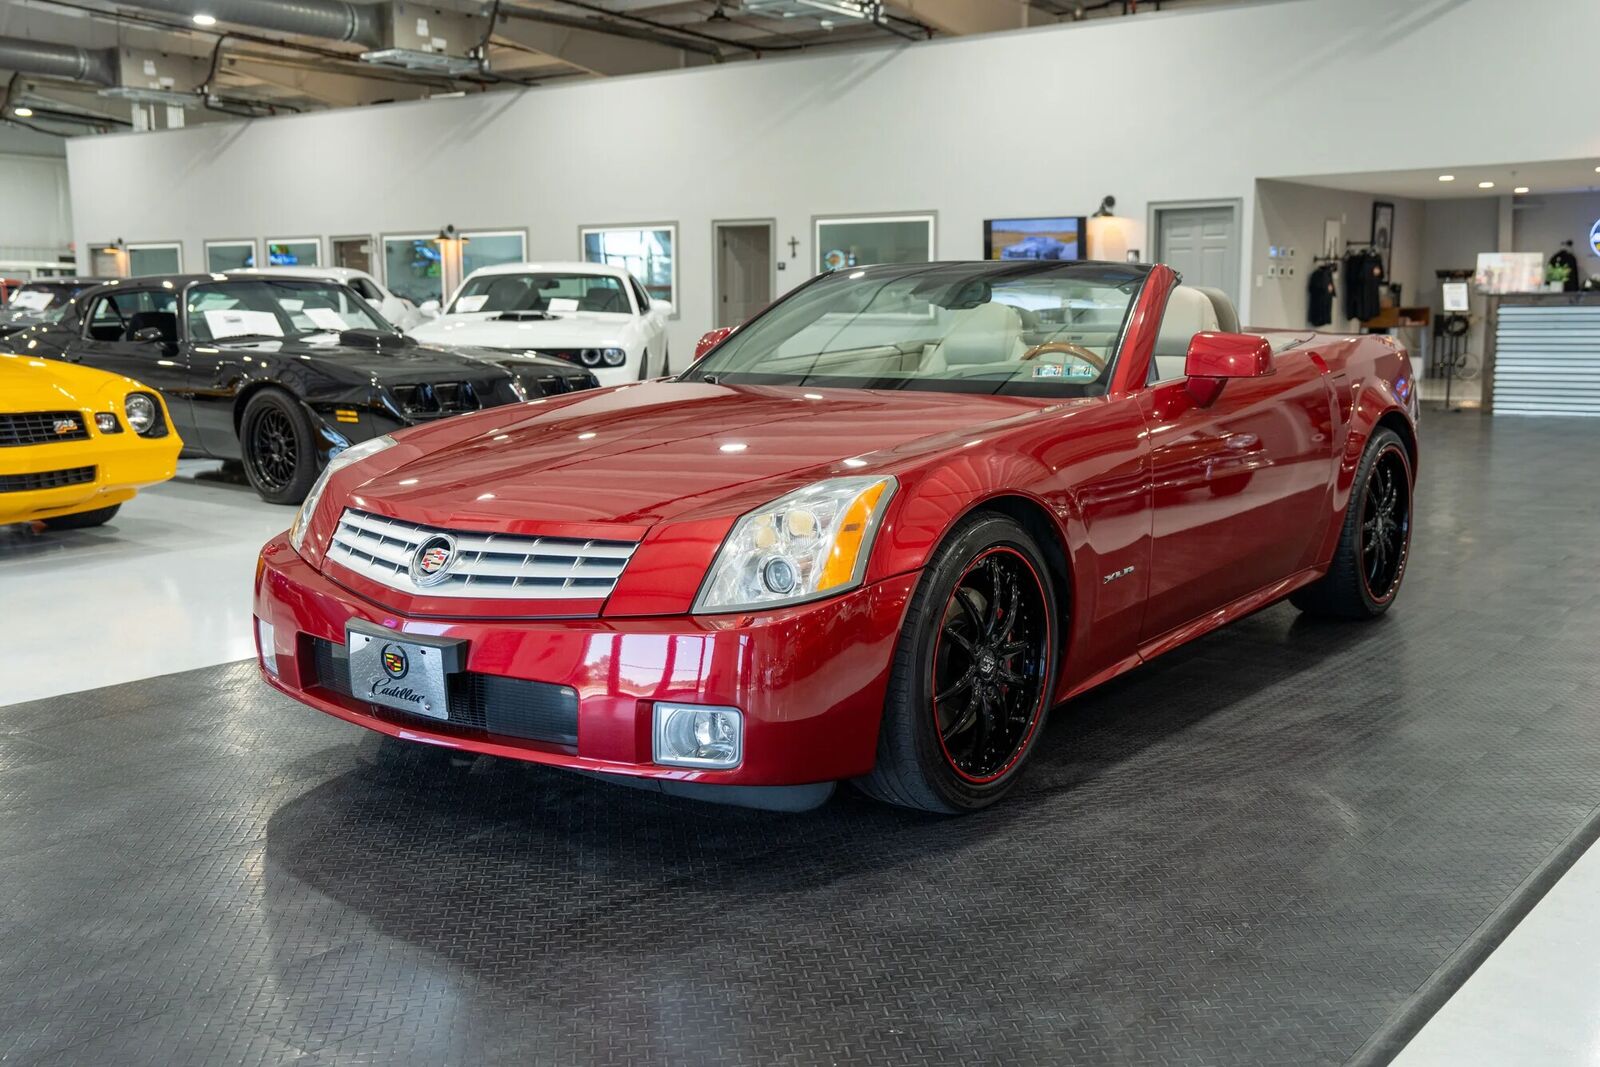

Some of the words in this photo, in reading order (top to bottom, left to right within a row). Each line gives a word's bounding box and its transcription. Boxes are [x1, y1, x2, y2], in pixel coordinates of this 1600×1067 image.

[53, 419, 78, 434] Z28
[1103, 565, 1135, 585] XLR
[372, 677, 425, 704] Cadillac
